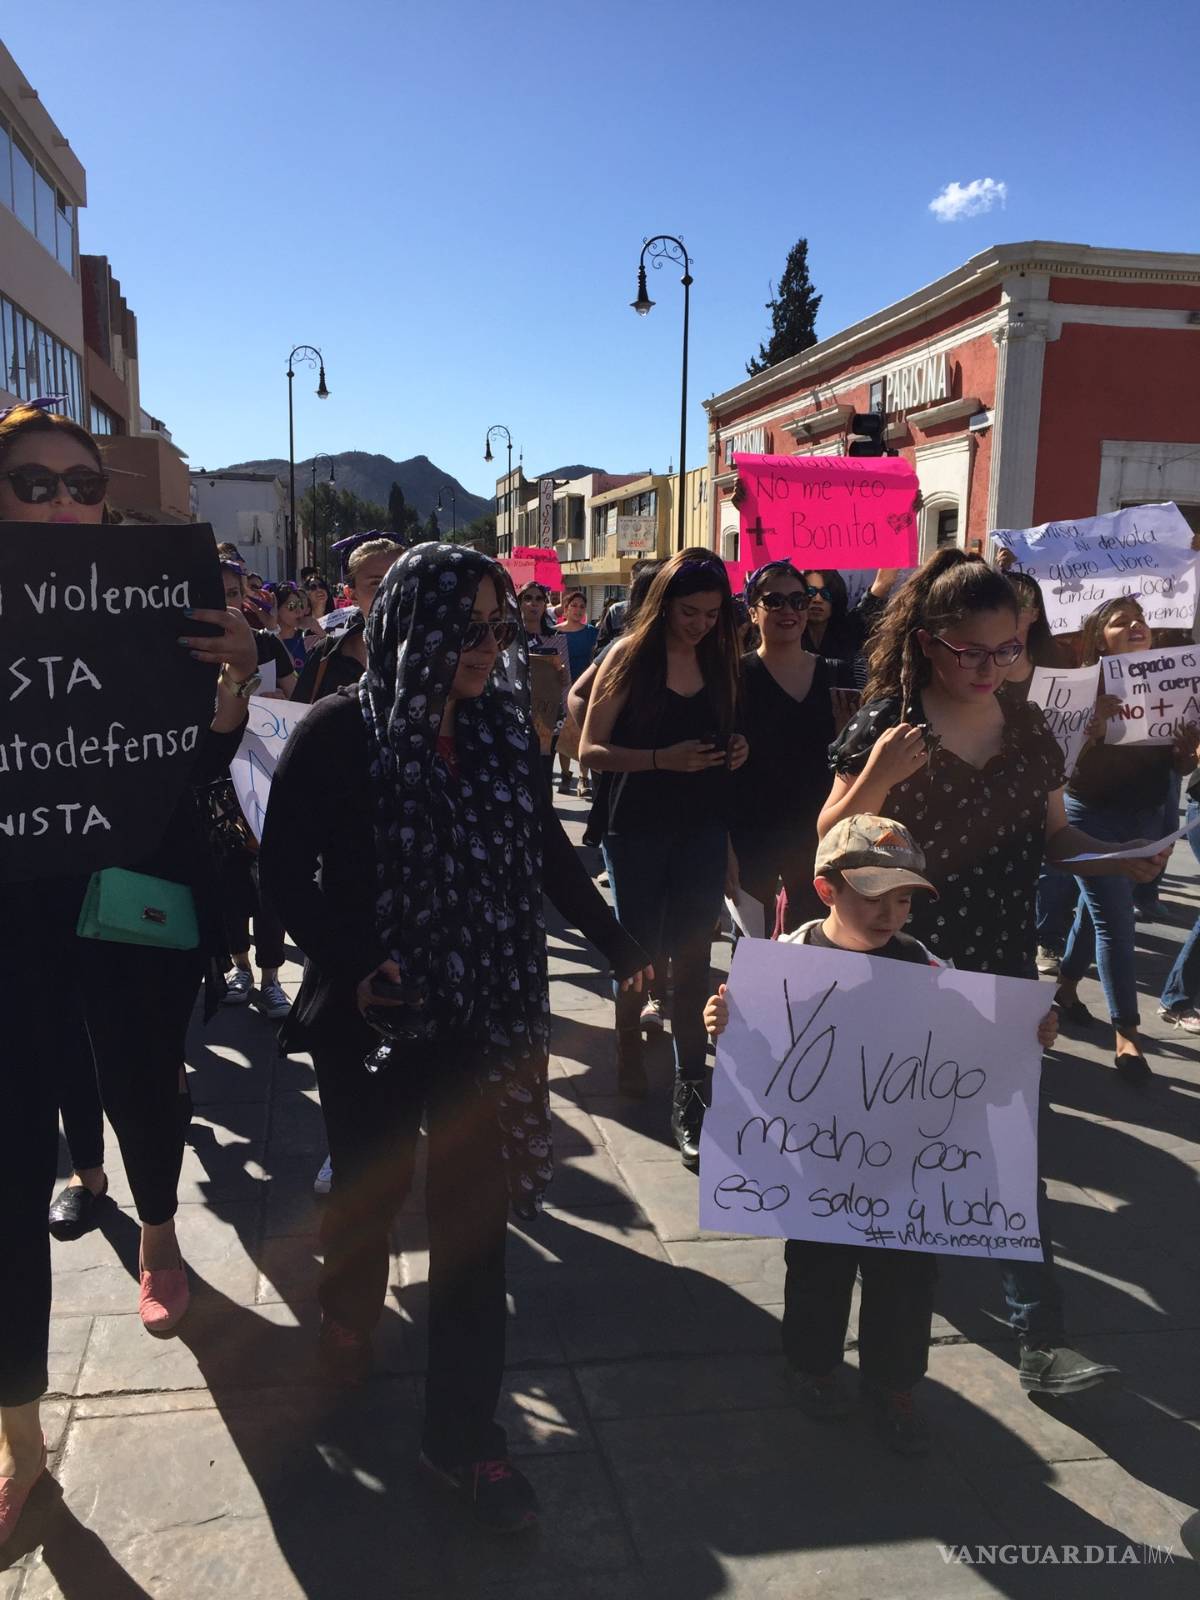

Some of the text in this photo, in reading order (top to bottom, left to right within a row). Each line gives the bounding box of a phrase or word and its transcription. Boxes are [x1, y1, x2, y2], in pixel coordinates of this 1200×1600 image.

[886, 352, 947, 414] PARISINA
[803, 480, 833, 500] me
[844, 479, 886, 499] veo
[792, 503, 878, 550] Bonita
[24, 561, 191, 614] violencia
[1108, 653, 1197, 680] El espacio es
[1132, 681, 1151, 695] mi
[911, 1141, 982, 1192] por
[713, 1174, 790, 1212] eso
[808, 1183, 890, 1232] salgo
[942, 1181, 1026, 1232] lucho
